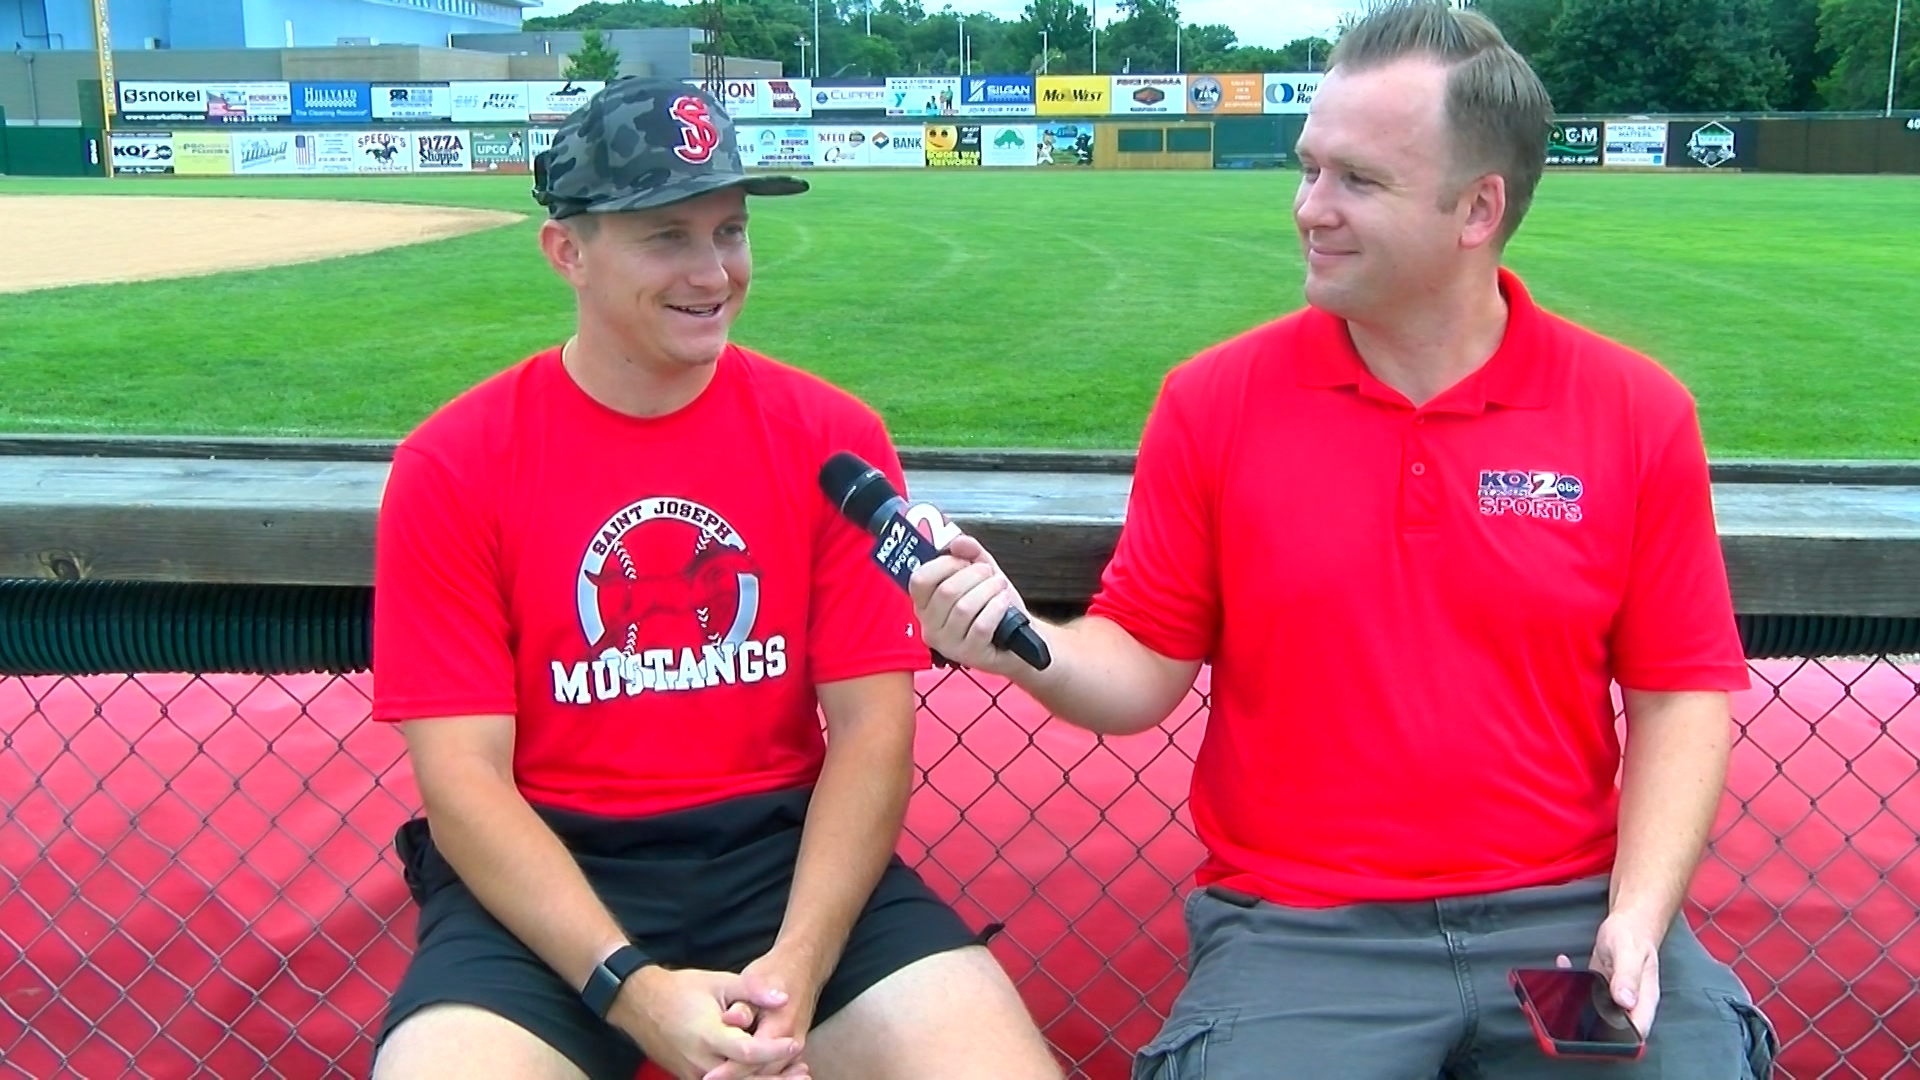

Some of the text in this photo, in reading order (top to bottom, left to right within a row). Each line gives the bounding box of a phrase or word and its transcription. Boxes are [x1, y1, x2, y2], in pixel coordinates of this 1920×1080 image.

[305, 87, 357, 100] HILLYARD
[987, 85, 1030, 94] SILGAN
[1297, 83, 1318, 92] Uni
[139, 89, 201, 102] snorkel
[248, 94, 288, 102] ROBERTS
[831, 90, 884, 100] CLIPPER
[1297, 94, 1312, 103] Re
[358, 133, 406, 148] SPEEDY'S
[418, 135, 463, 151] PIZZA
[893, 137, 922, 150] BANK
[477, 145, 508, 154] UPCO
[1479, 498, 1583, 522] SPORTS
[592, 500, 734, 557] SAINT JOSEPH
[904, 502, 963, 551] 2
[890, 535, 919, 576] SPORTS
[551, 634, 787, 705] MUSTANGS
